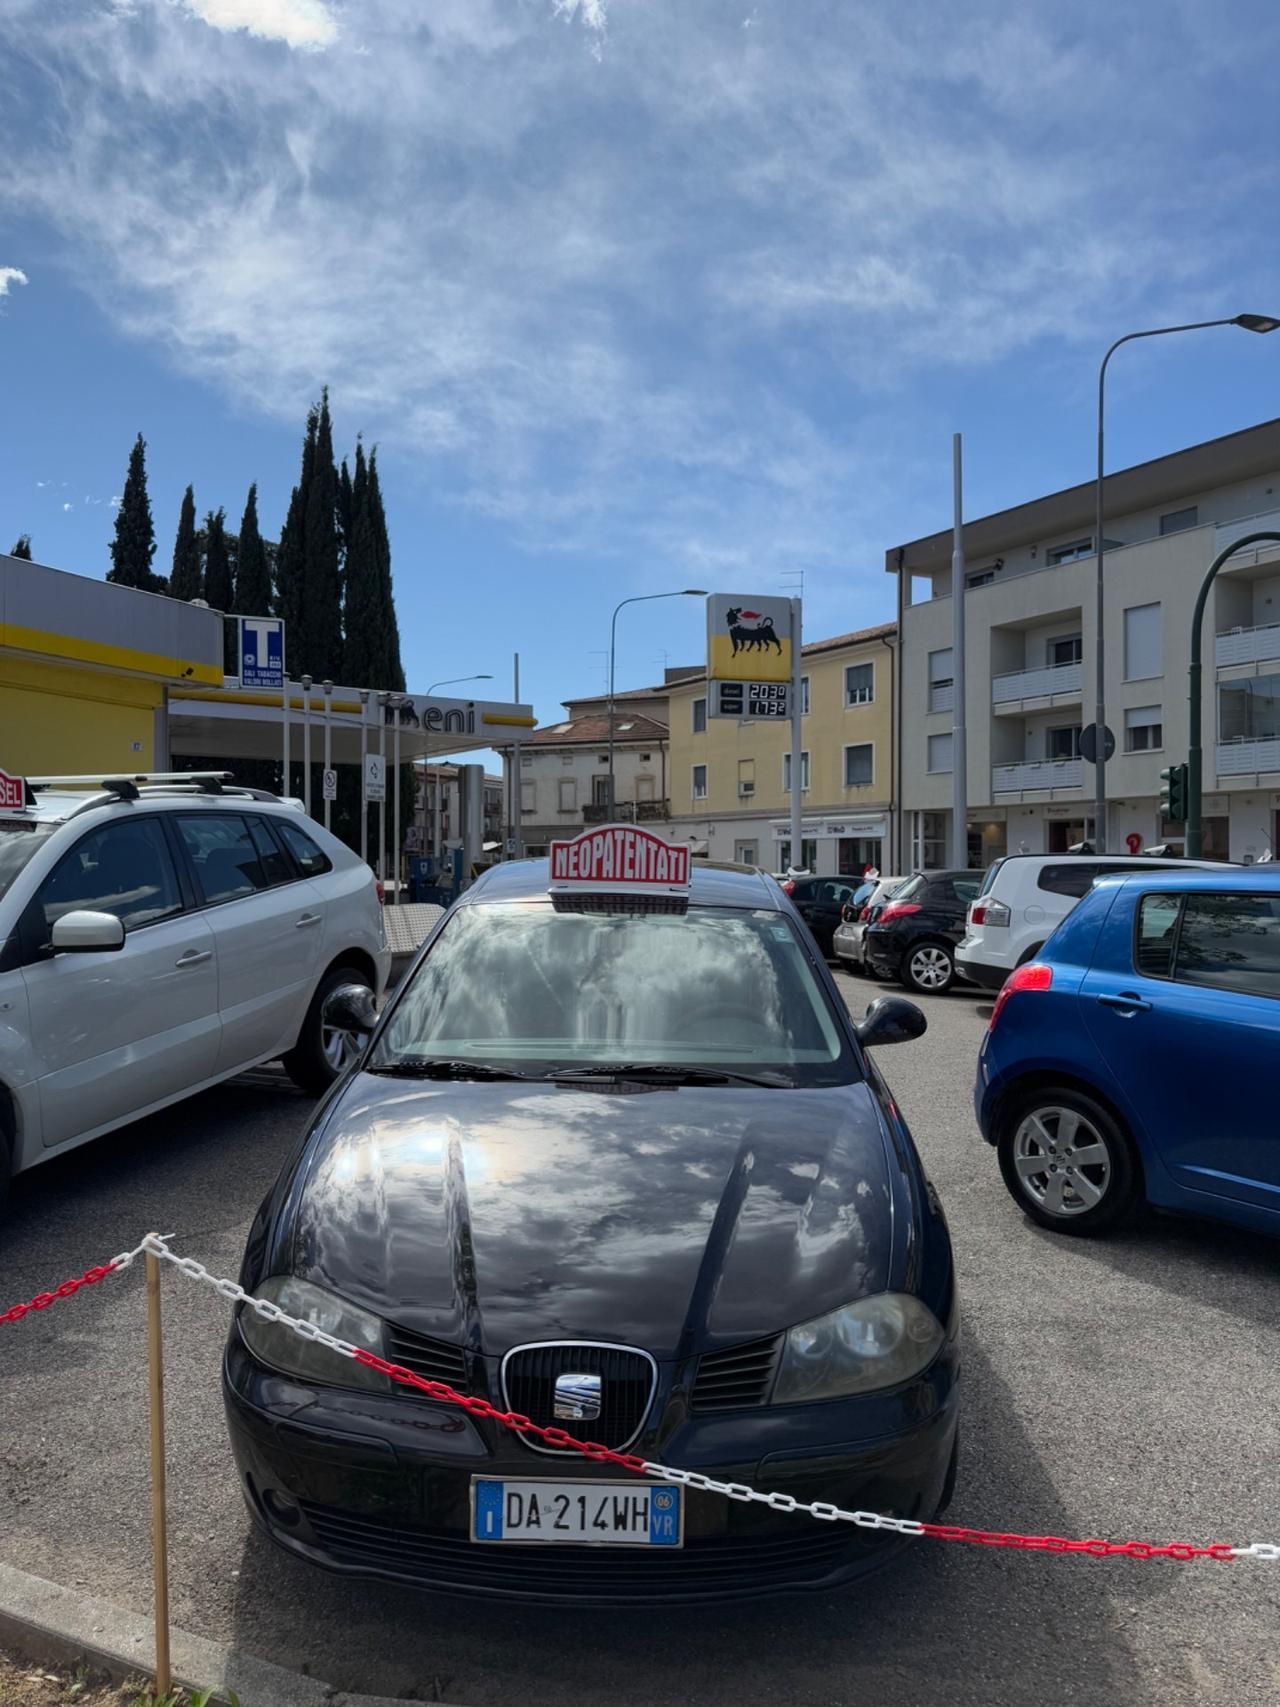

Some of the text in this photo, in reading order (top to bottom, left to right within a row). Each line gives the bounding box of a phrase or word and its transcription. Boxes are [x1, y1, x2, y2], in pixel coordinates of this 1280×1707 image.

[245, 621, 280, 668] T
[424, 701, 475, 734] eni
[555, 830, 684, 881] NEOPATENTATI
[652, 1515, 673, 1536] VR
